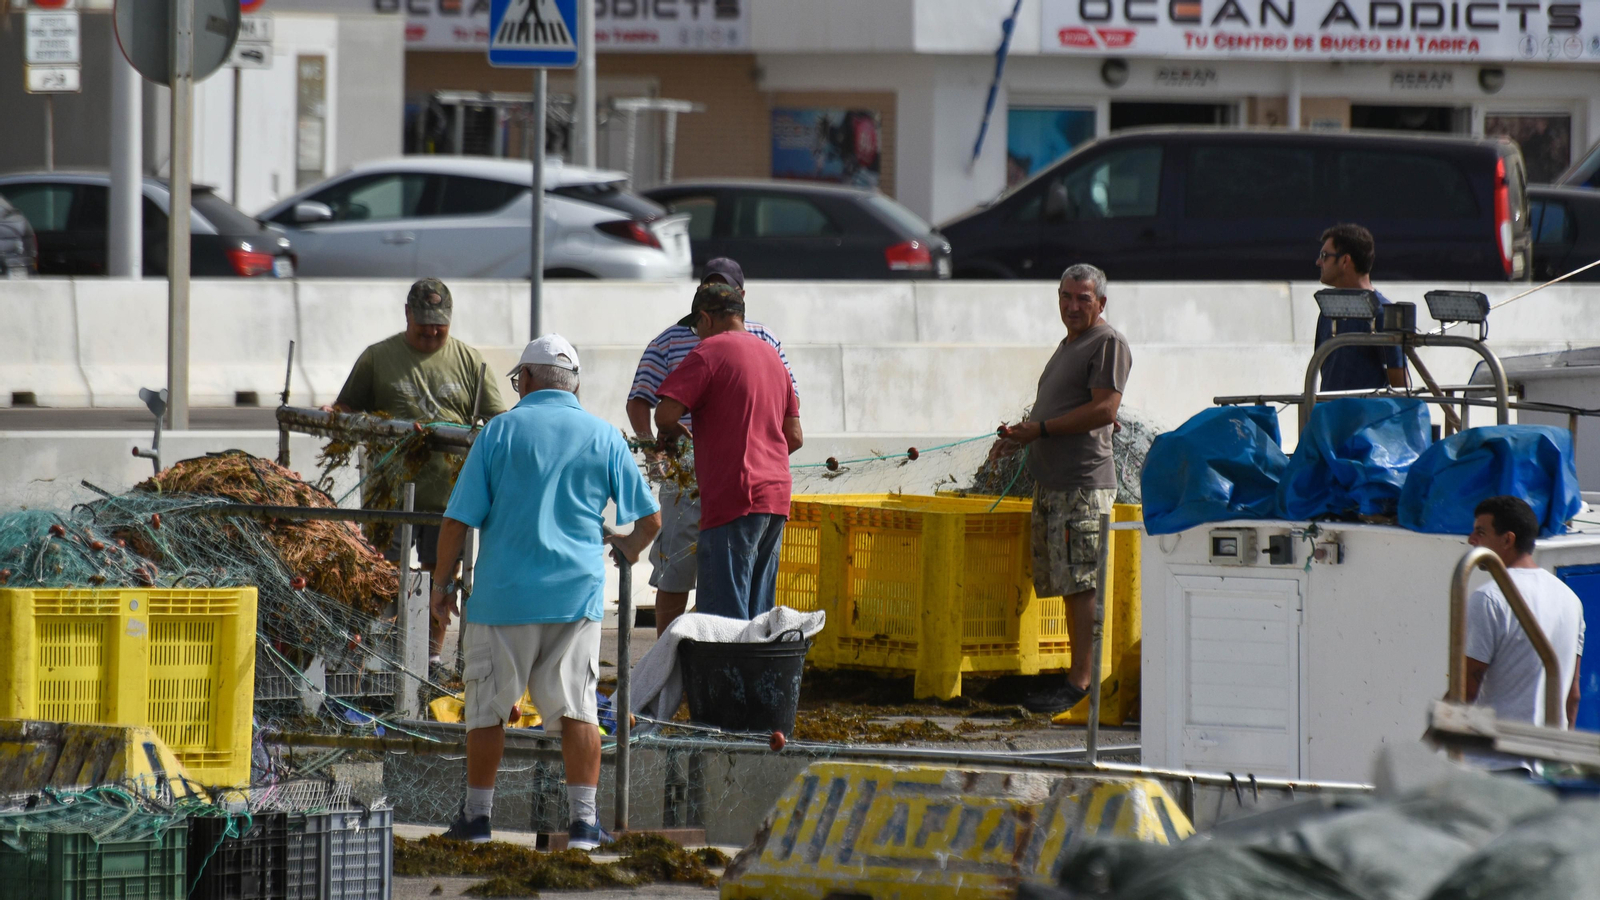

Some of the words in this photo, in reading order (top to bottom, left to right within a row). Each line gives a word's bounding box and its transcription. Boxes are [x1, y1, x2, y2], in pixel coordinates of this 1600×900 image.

[1079, 0, 1296, 27] OCEAN
[1318, 0, 1582, 32] ADDICTS
[1184, 31, 1208, 48] TU
[1214, 31, 1288, 50] CENTRO
[1294, 35, 1314, 49] DE
[1320, 33, 1381, 51] BUCEO
[1387, 36, 1410, 52] EN
[1416, 34, 1480, 55] TARIFA
